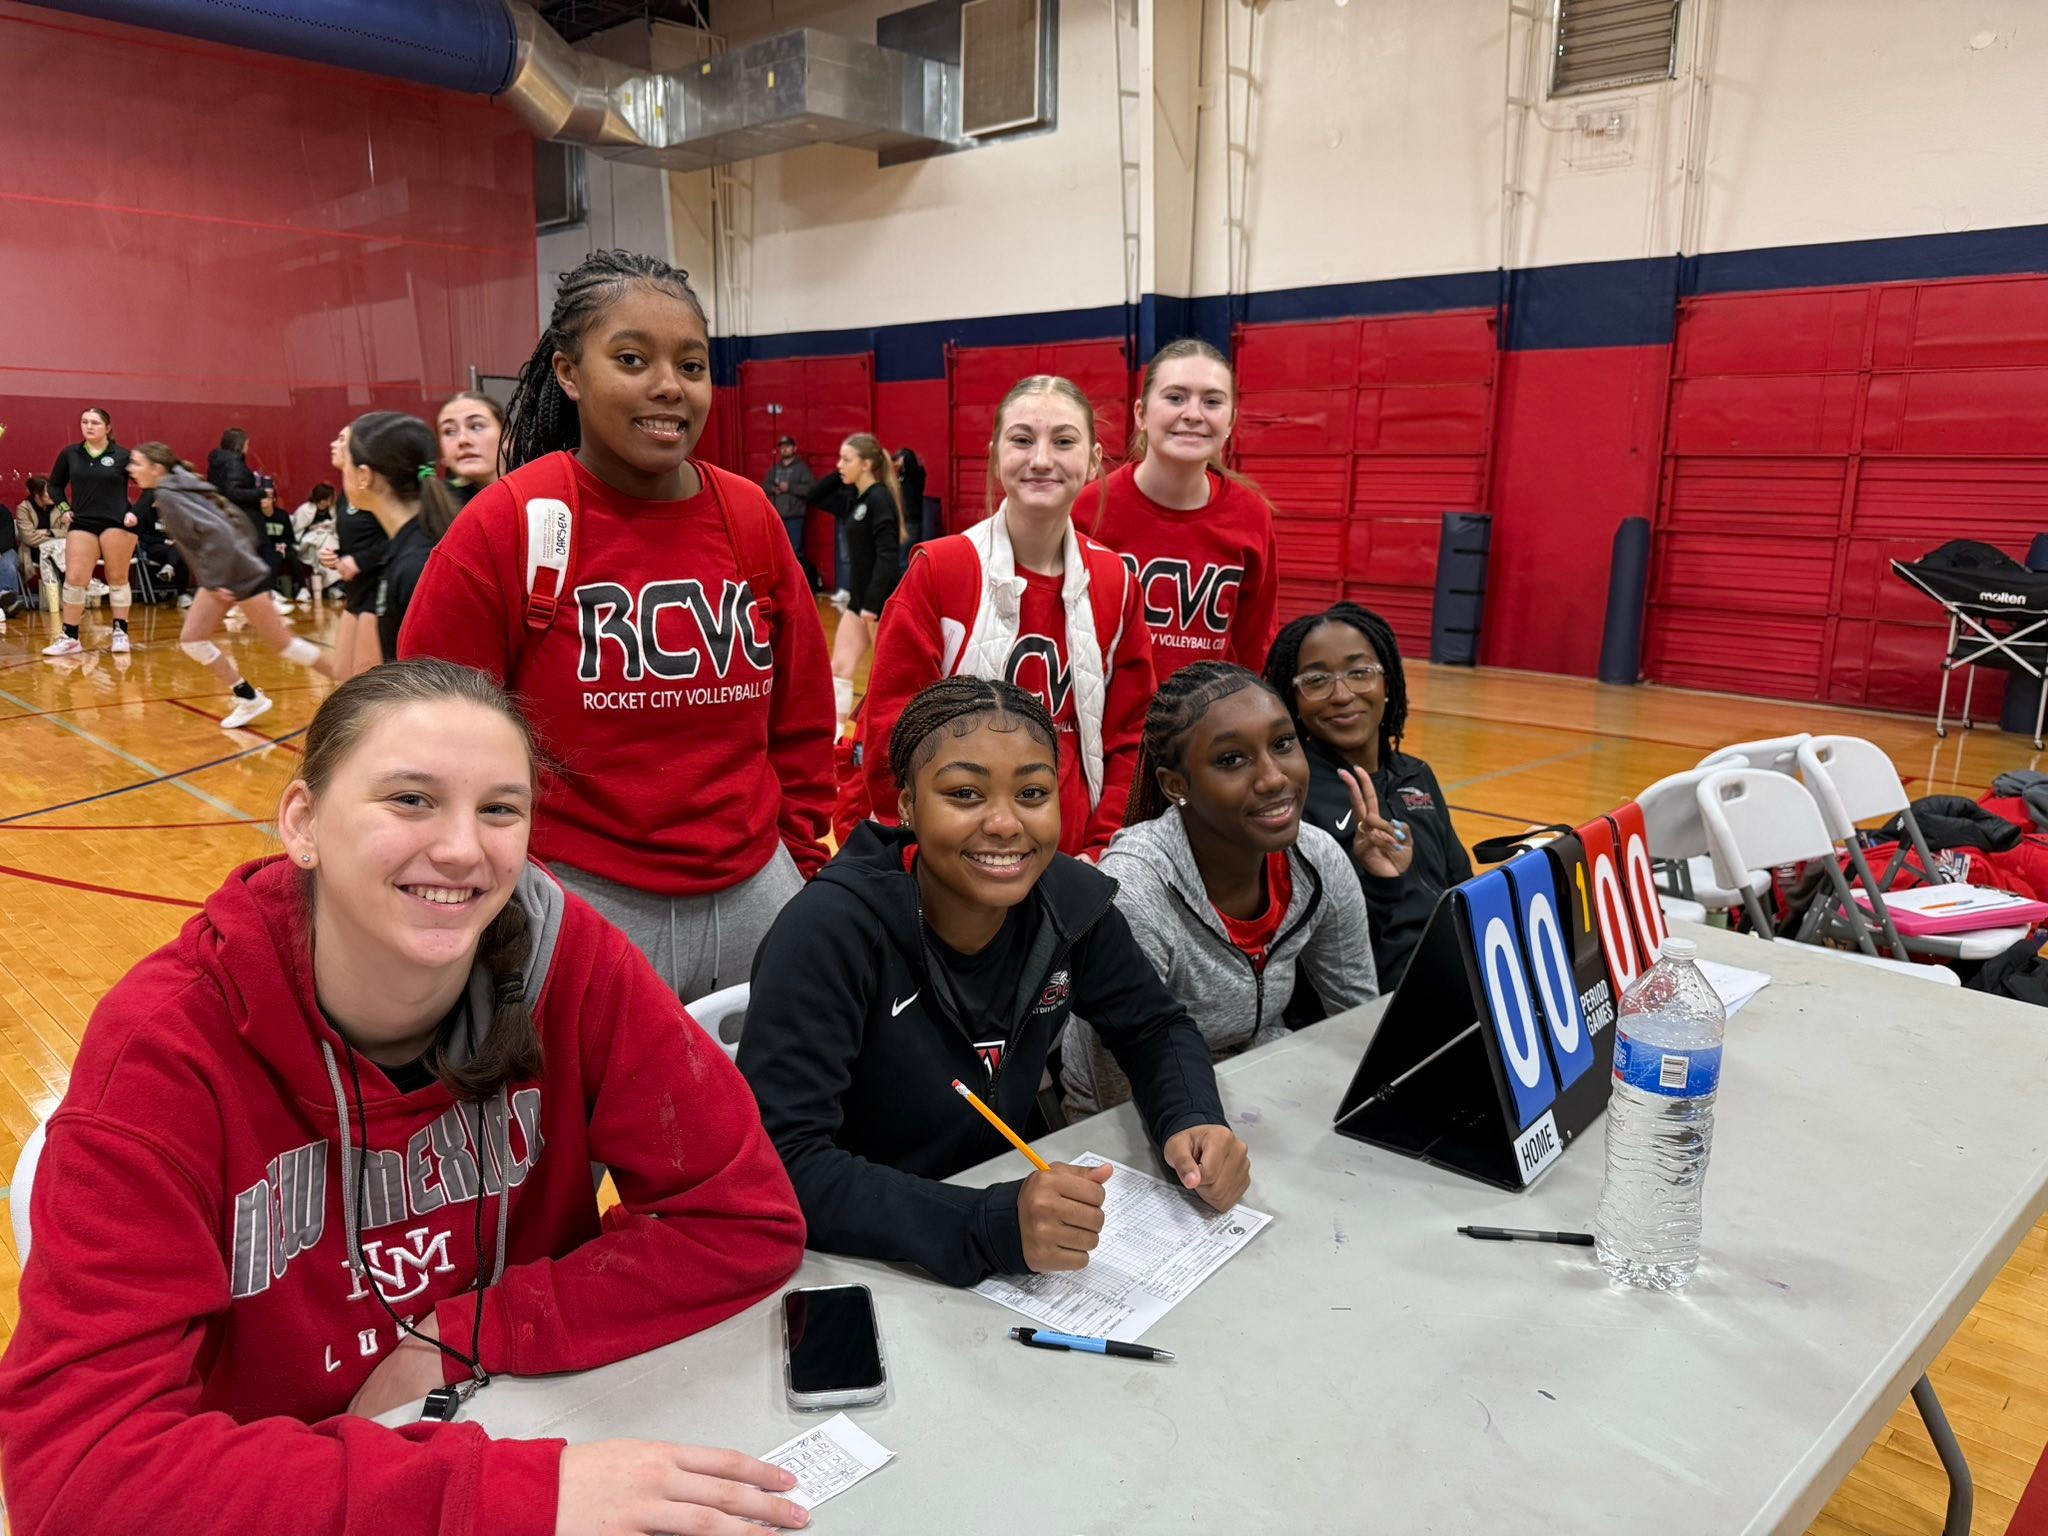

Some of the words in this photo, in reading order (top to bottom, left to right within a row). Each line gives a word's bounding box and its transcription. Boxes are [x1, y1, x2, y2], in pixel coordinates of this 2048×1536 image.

[555, 512, 567, 555] CARSEN
[1118, 553, 1244, 633] CVC
[1979, 592, 2027, 605] molten
[574, 578, 773, 682] RCVC
[1159, 634, 1211, 650] VOLLEYBALL
[583, 692, 647, 710] ROCKET
[650, 690, 683, 709] CITY
[685, 682, 761, 706] VOLLEYBALL
[1579, 978, 1610, 1012] PERIOD
[1585, 1000, 1615, 1038] GAMES
[350, 1087, 546, 1231] MEXICO
[1520, 1122, 1554, 1173] HOME
